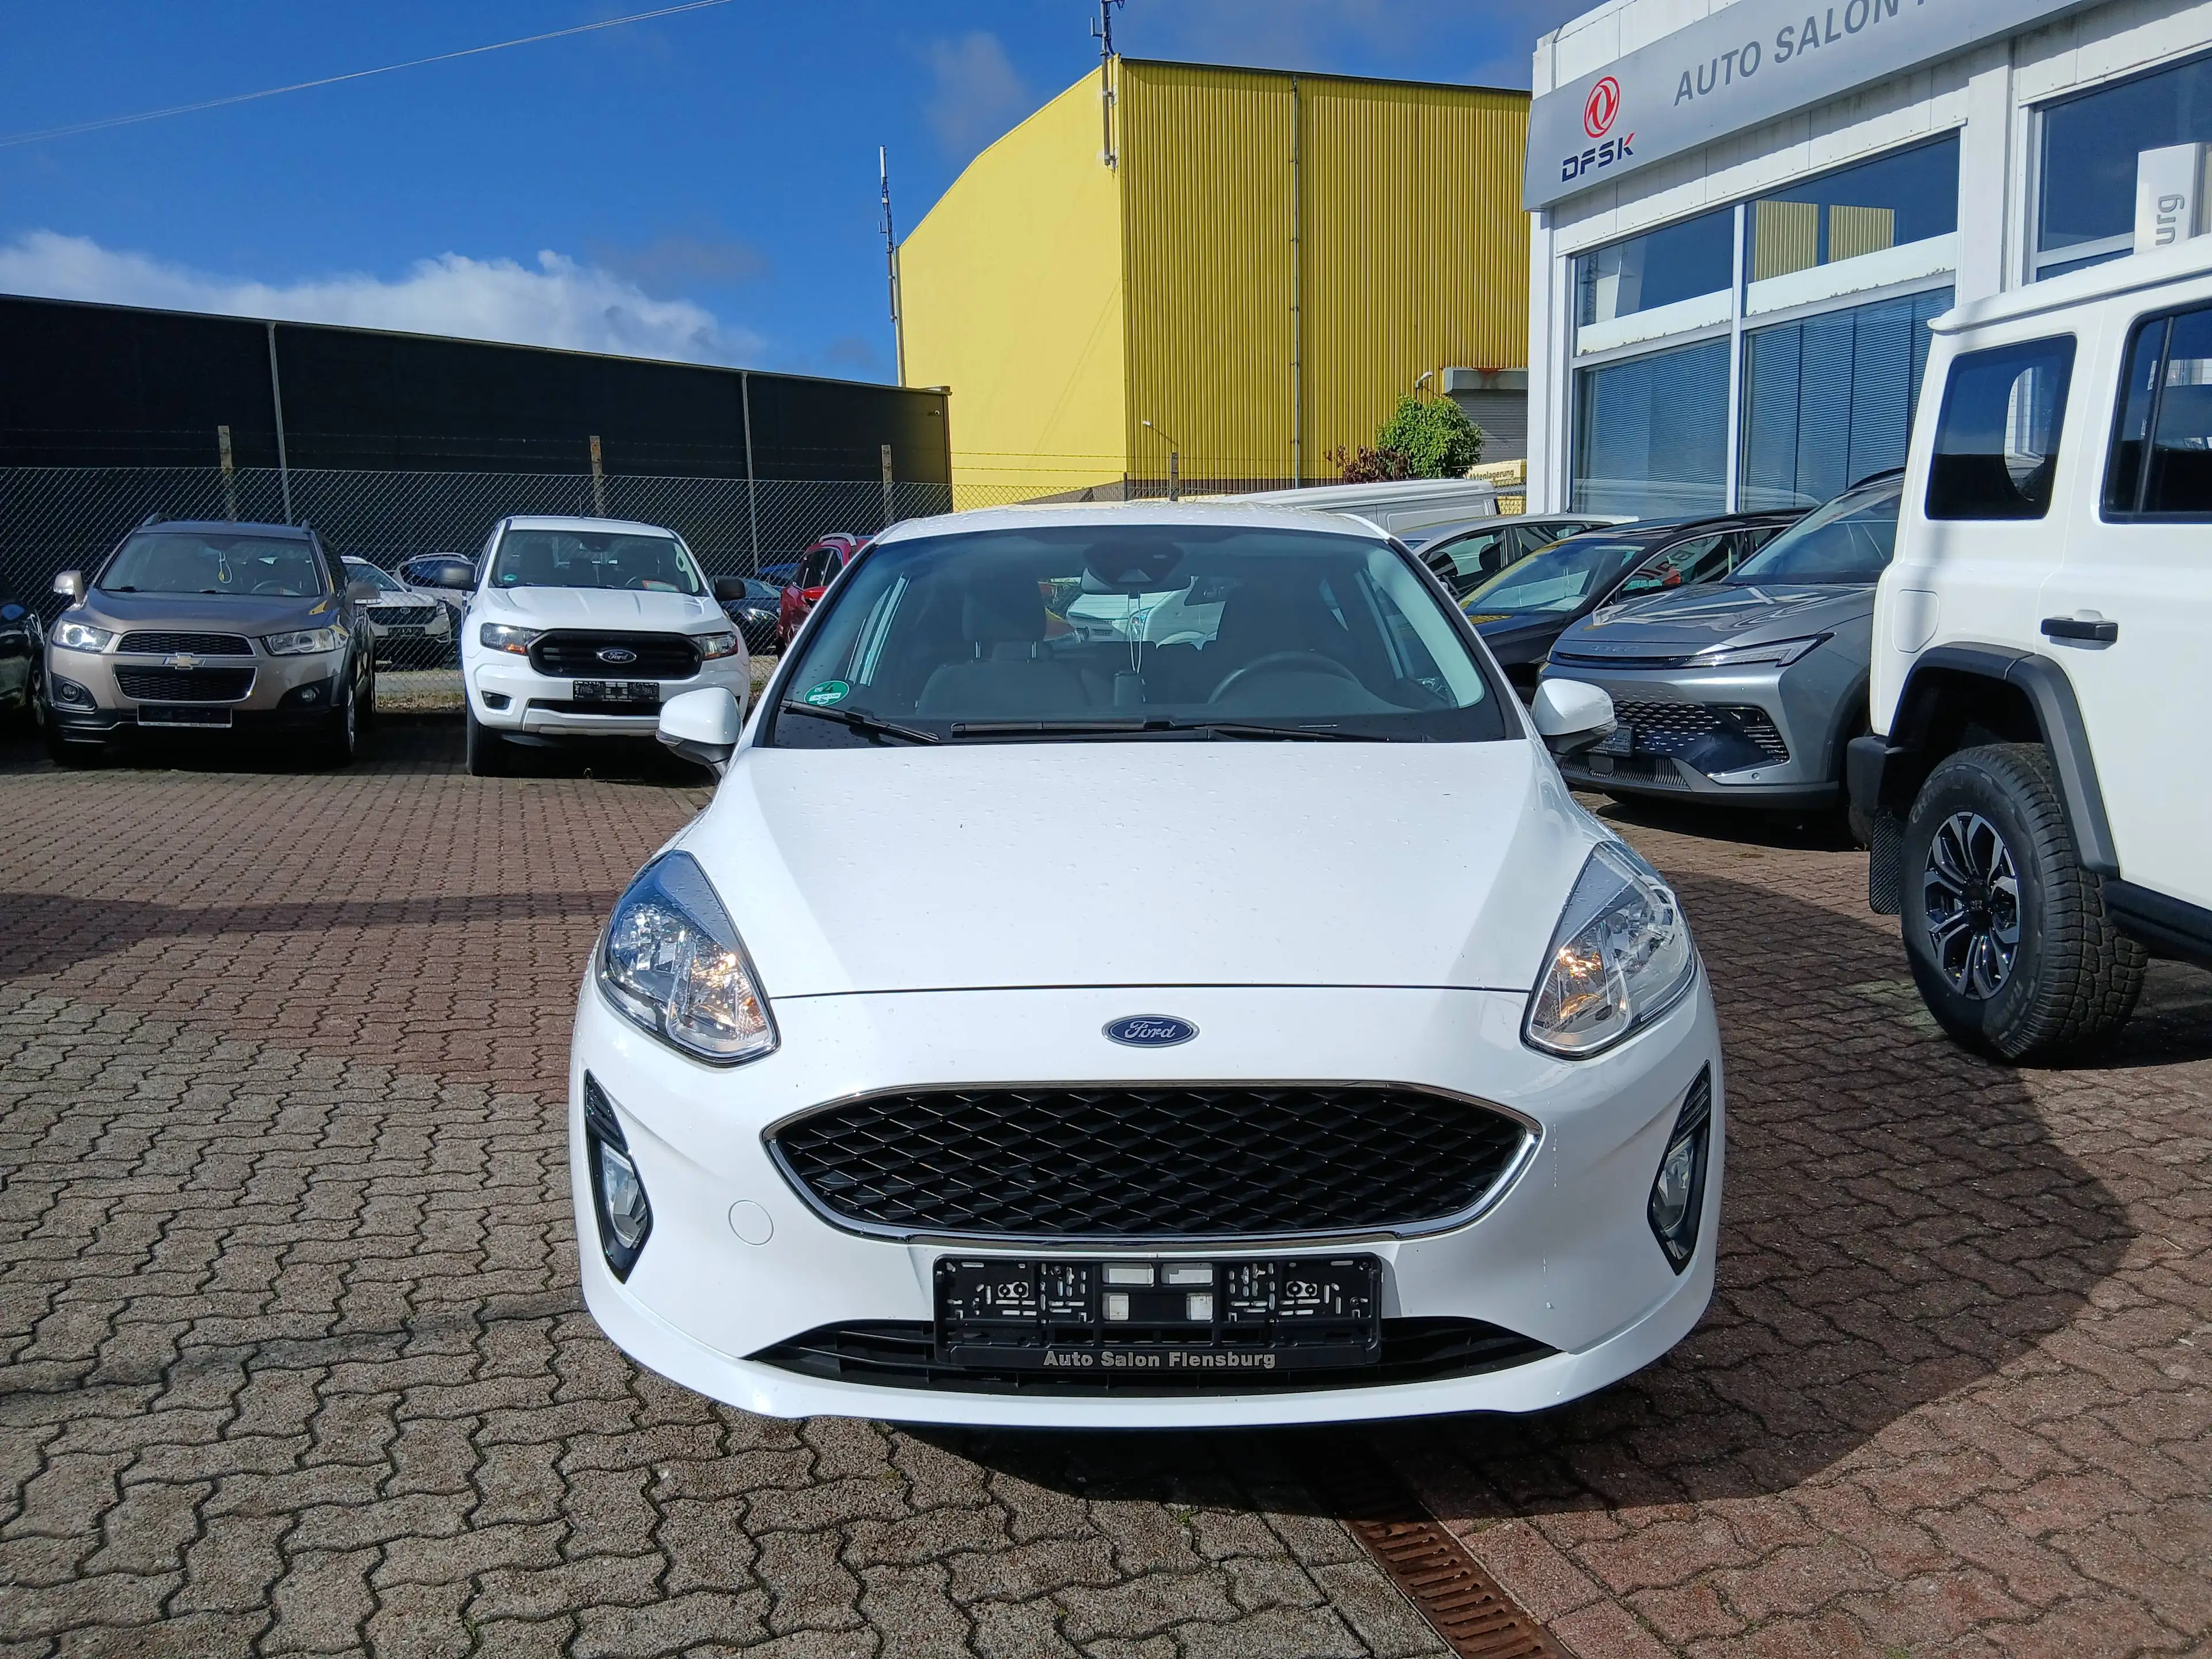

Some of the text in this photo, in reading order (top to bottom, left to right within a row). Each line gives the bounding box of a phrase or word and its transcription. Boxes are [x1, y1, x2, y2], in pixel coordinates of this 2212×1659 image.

[1673, 0, 1899, 107] AUTO SALON
[1562, 131, 1635, 183] DFSK
[608, 651, 629, 660] Ford
[1124, 1020, 1177, 1039] Ford
[1043, 1350, 1276, 1369] Auto Salon Flensburg
